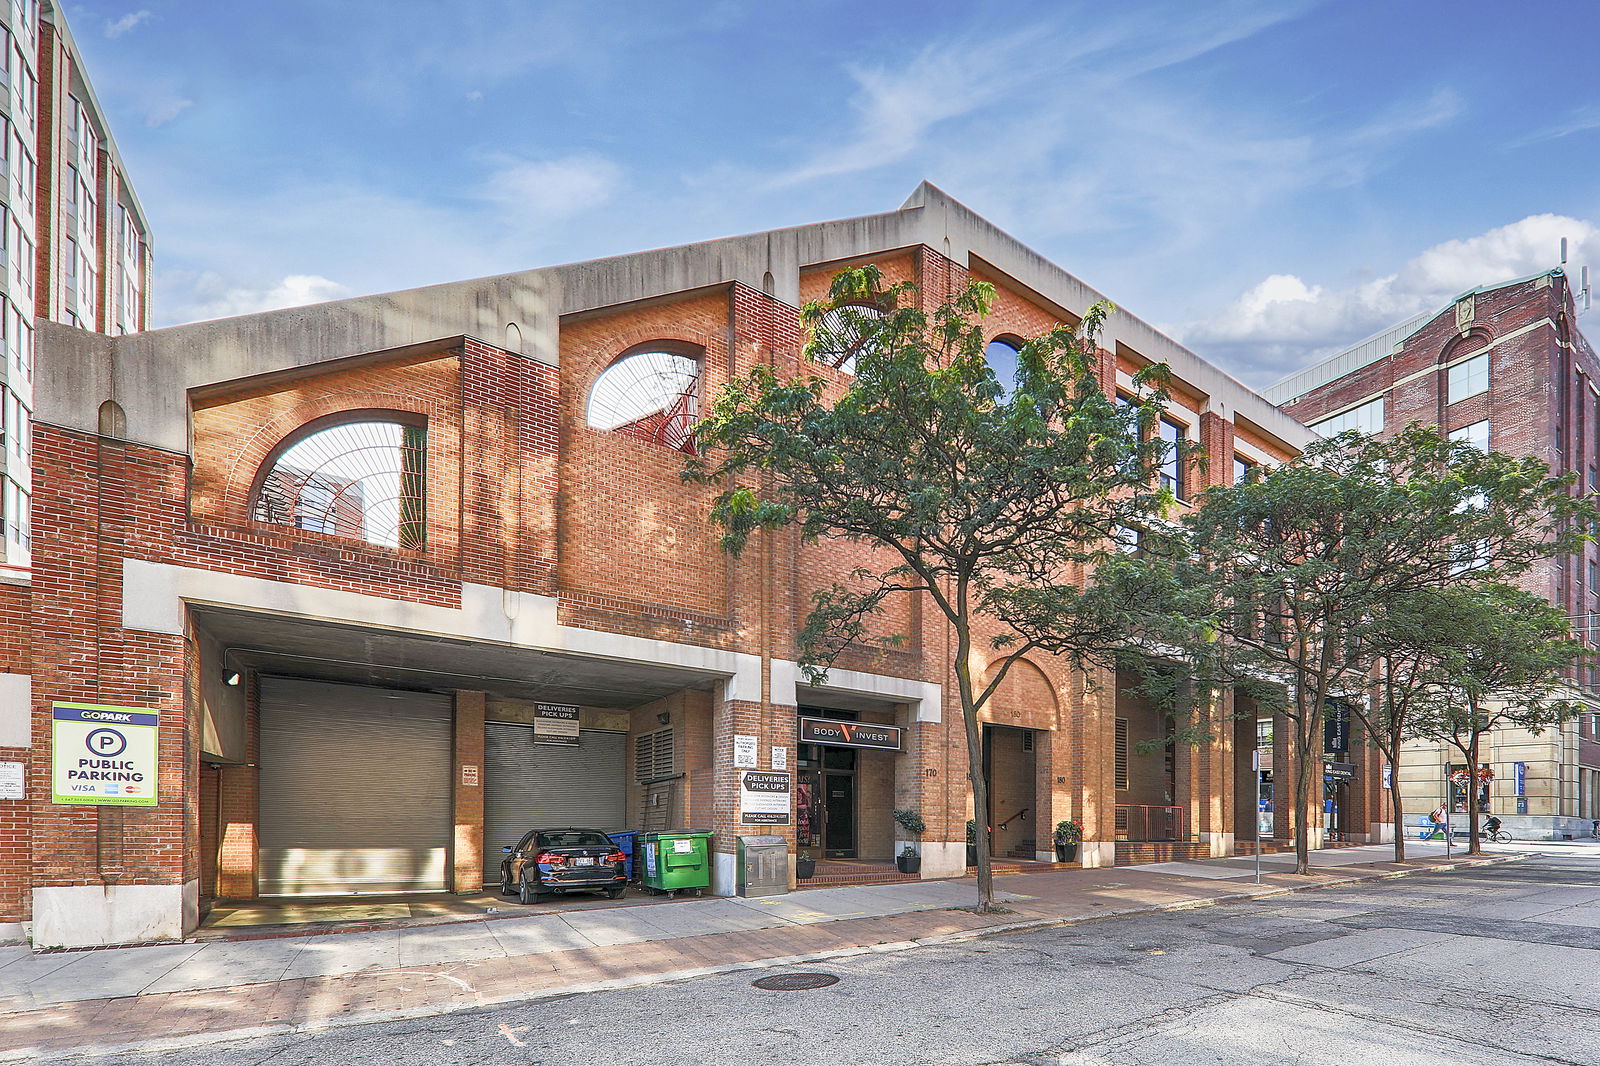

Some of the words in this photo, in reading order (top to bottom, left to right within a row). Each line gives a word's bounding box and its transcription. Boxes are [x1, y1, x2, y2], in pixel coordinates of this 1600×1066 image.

[538, 704, 576, 712] DELIVERIES
[80, 711, 132, 722] GOPARK
[814, 728, 840, 736] BODY
[856, 732, 888, 741] INVEST
[100, 736, 114, 749] P
[79, 759, 134, 770] PUBLIC
[68, 770, 144, 782] PARKING
[925, 768, 937, 777] 170
[748, 775, 788, 783] DELIVERIES
